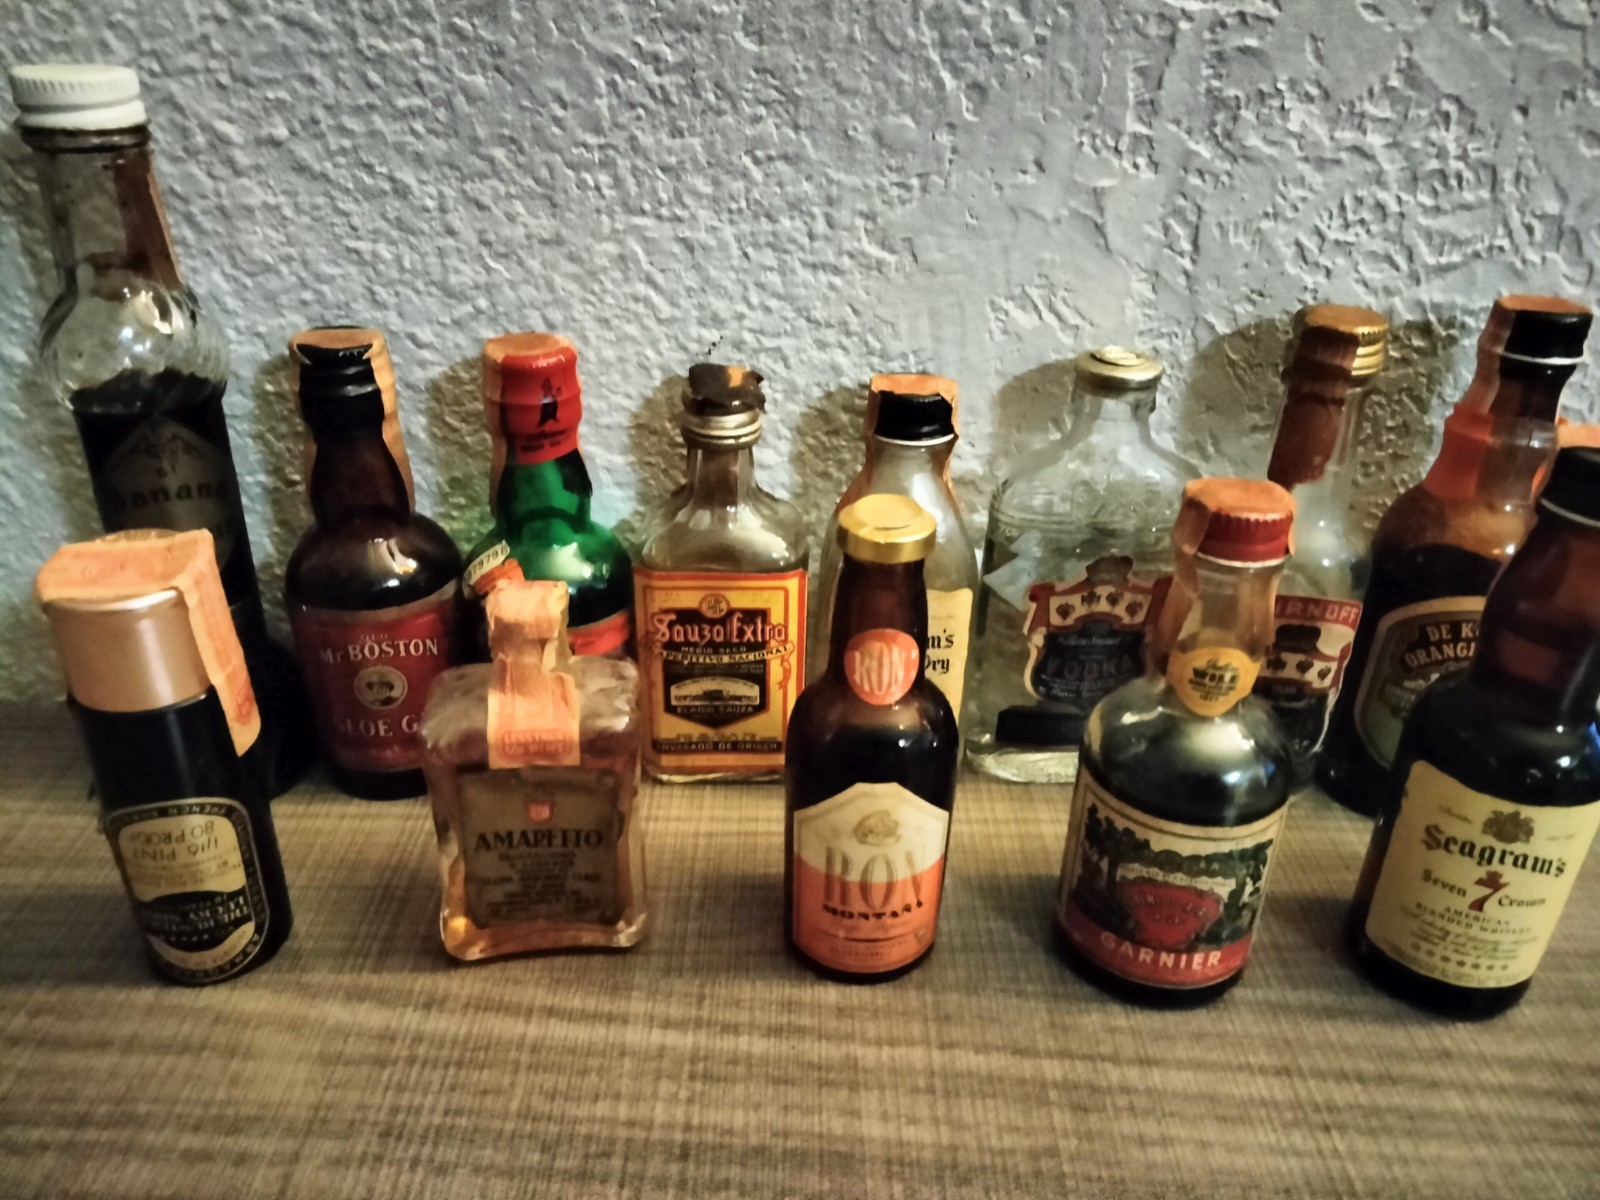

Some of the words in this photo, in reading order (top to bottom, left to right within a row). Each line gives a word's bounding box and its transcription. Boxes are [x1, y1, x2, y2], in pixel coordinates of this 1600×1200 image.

[653, 611, 725, 646] Sauza
[727, 611, 787, 645] Extra
[1425, 624, 1452, 642] DE
[348, 637, 439, 662] BOSTON
[190, 821, 215, 840] 80
[1421, 823, 1568, 878] Seagram's
[1421, 867, 1468, 899] Seven
[1467, 869, 1511, 913] 7
[1497, 893, 1547, 908] Crown
[1414, 901, 1474, 931] BLENDED
[1101, 931, 1223, 971] GARNIER
